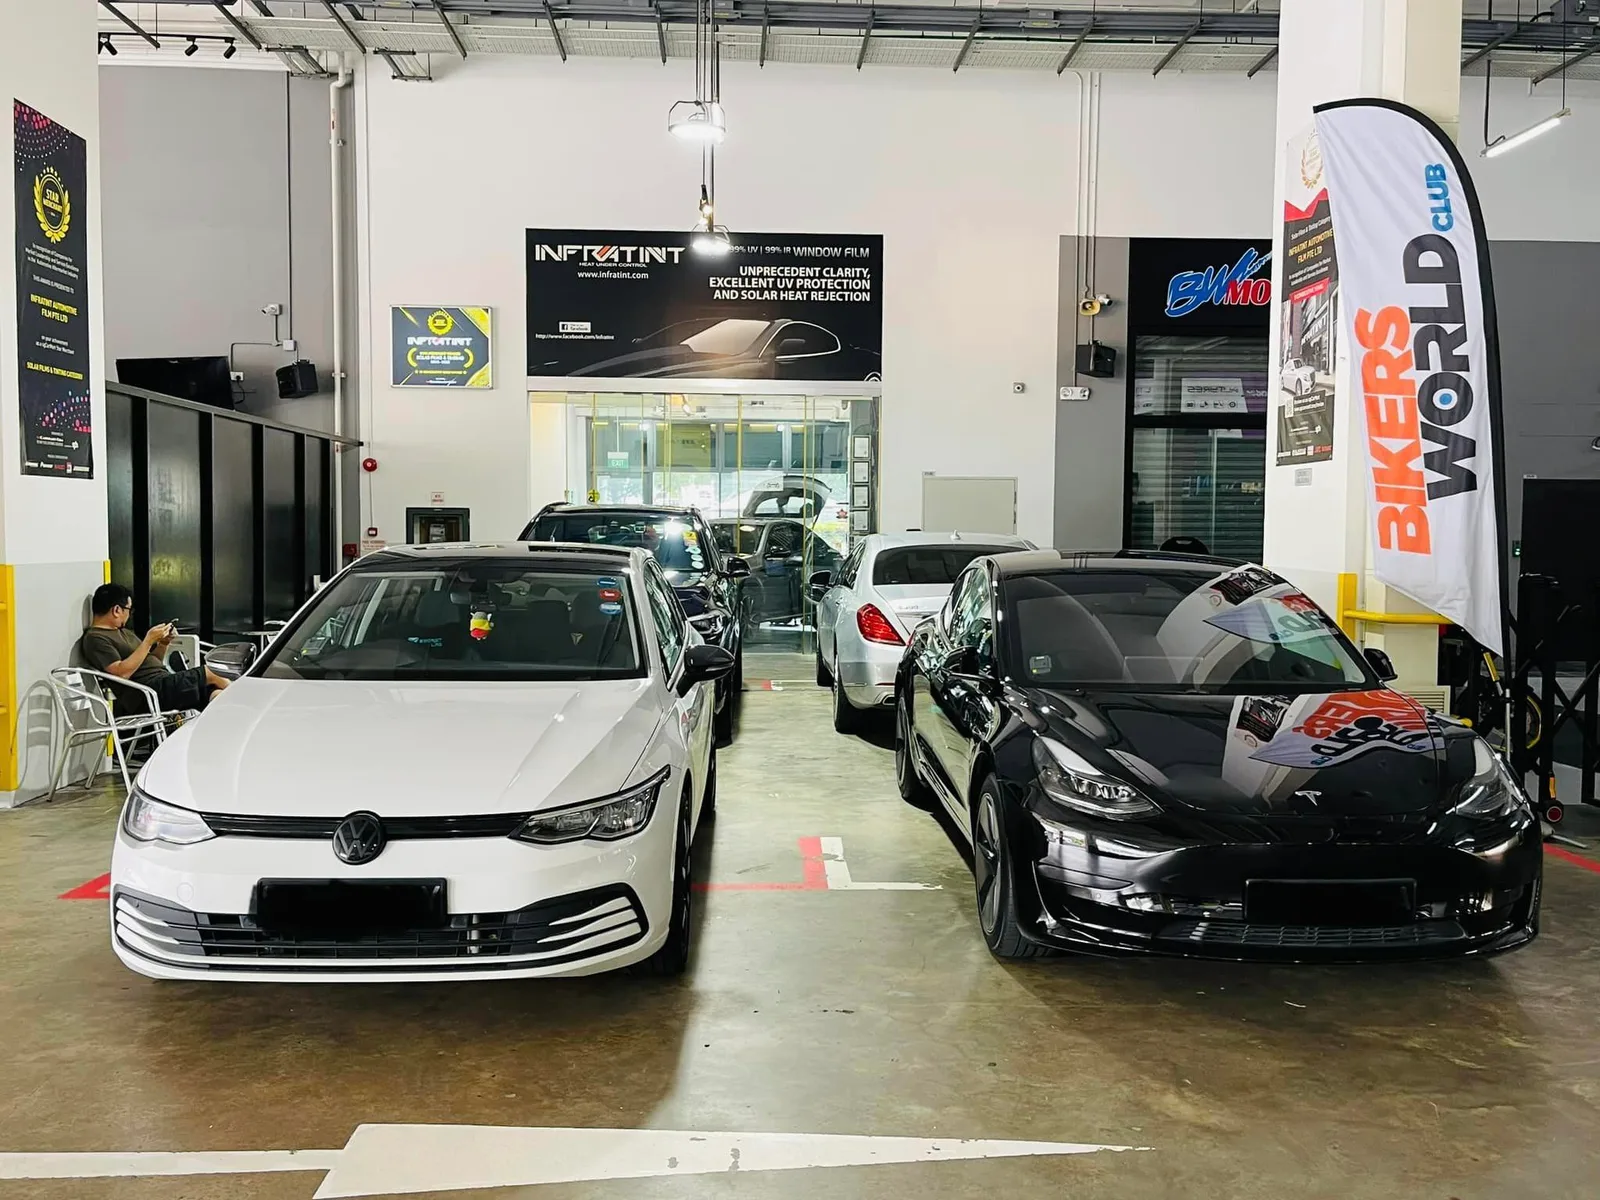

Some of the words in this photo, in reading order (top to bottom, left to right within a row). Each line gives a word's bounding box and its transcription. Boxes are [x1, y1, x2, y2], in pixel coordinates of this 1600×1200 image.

[1424, 162, 1454, 232] CLUB
[535, 244, 686, 263] INFRATINT
[747, 245, 758, 254] UV
[765, 246, 782, 254] 99%
[783, 246, 791, 254] IR
[793, 247, 841, 258] WINDOW
[844, 248, 870, 258] FILM
[577, 270, 649, 279] www.infratint.com
[739, 266, 821, 278] UNPRECEDENT
[822, 267, 871, 279] CLARITY,
[709, 277, 774, 289] EXCELLENT
[776, 278, 794, 289] UV
[796, 279, 870, 290] PROTECTION
[713, 290, 739, 300] AND
[740, 290, 778, 301] SOLAR
[780, 291, 808, 301] HEAT
[811, 292, 870, 302] REJECTION
[1403, 233, 1477, 501] WORLD
[1354, 305, 1432, 555] BIKERS
